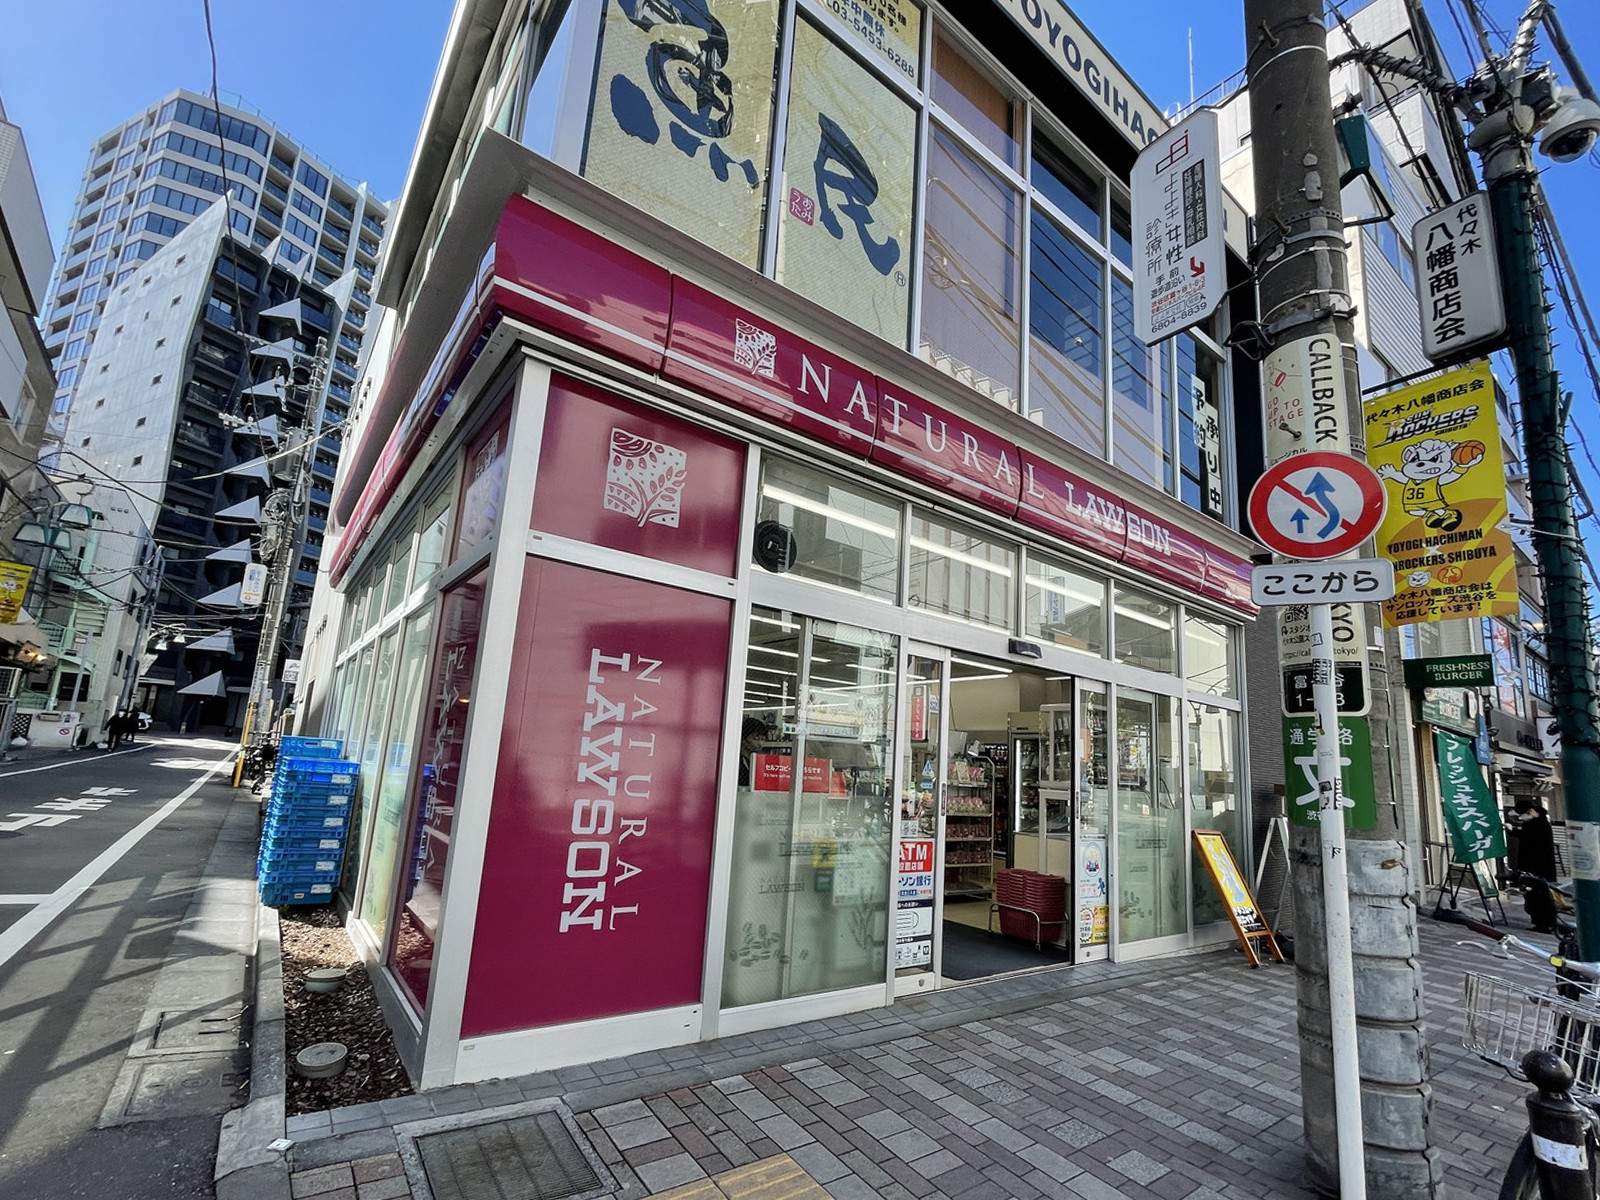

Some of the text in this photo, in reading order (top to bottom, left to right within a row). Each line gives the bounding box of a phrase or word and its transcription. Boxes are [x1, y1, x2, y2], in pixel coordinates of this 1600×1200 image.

[1009, 0, 1160, 146] OYOGIHA
[1457, 203, 1481, 256] 代々木
[1145, 218, 1162, 277] 診療所
[1426, 222, 1466, 344] 八幡商店会
[1151, 301, 1207, 333] 6804-8839
[1267, 396, 1279, 410] GO
[1308, 338, 1338, 444] CALLBACK
[1366, 379, 1485, 425] 代々木八幡商店会
[1268, 398, 1301, 420] UP TO
[1268, 407, 1304, 431] STAGE
[798, 353, 1172, 557] NATURAL LAWSON
[1406, 487, 1425, 500] 36
[1387, 528, 1483, 555] YOYOGI HACHIMAN
[1392, 546, 1497, 573] NROCKERS SHIBUYA
[1263, 570, 1379, 596] ここから
[1386, 590, 1497, 612] サンロッカーズ渋谷を
[1426, 661, 1491, 673] FRESHNESS
[1435, 671, 1484, 681] BURGER
[1293, 673, 1346, 690] 富谷
[559, 648, 631, 933] LAWSON
[609, 655, 663, 931] NATURAL
[1446, 738, 1493, 859] フレッシュネスバーガー
[898, 875, 932, 887] ソン銀行
